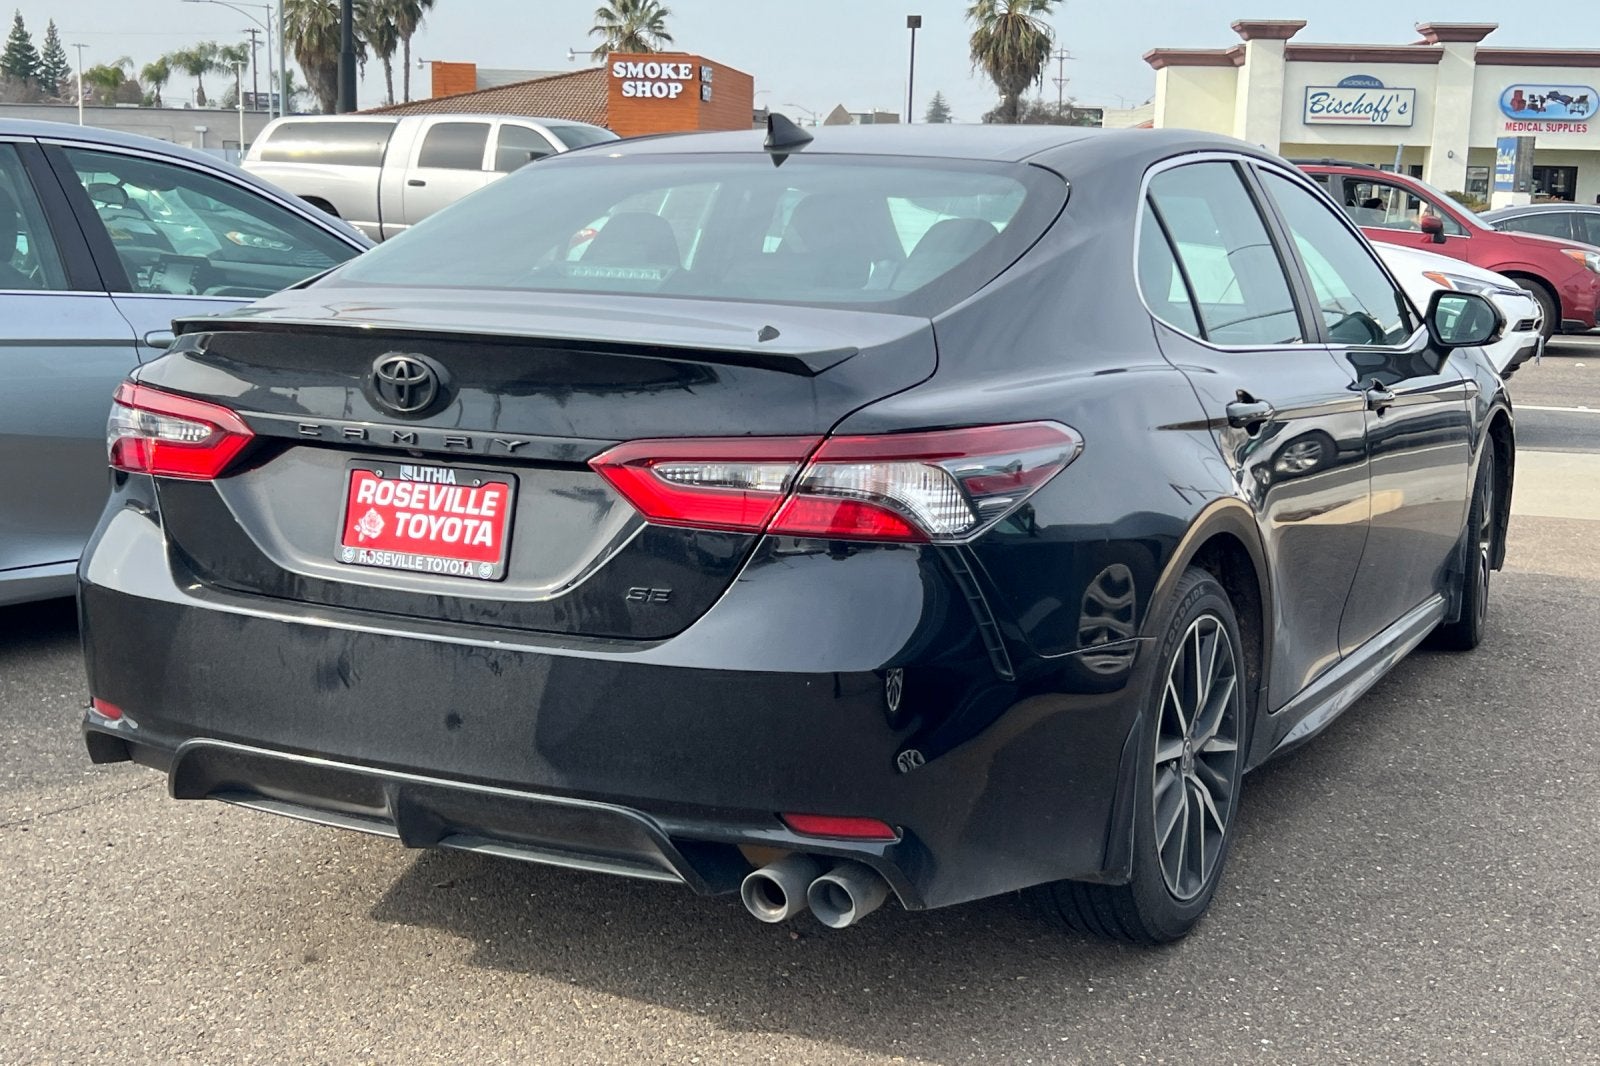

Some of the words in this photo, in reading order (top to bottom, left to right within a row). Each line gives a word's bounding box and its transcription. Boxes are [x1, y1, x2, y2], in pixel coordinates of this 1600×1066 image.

[612, 62, 693, 80] SMOKE
[622, 81, 683, 98] SHOP
[1309, 92, 1408, 122] Bischoff's
[1505, 122, 1543, 132] MEDICAL
[1546, 123, 1588, 133] SUPPLIES
[298, 423, 530, 453] CAMRY
[411, 467, 456, 485] LITHIA
[357, 479, 499, 517] ROSEVILLE
[395, 511, 493, 547] TOYOTA
[359, 551, 423, 569] ROSEVILLE
[426, 557, 474, 576] TOYOTA
[625, 586, 673, 602] SE
